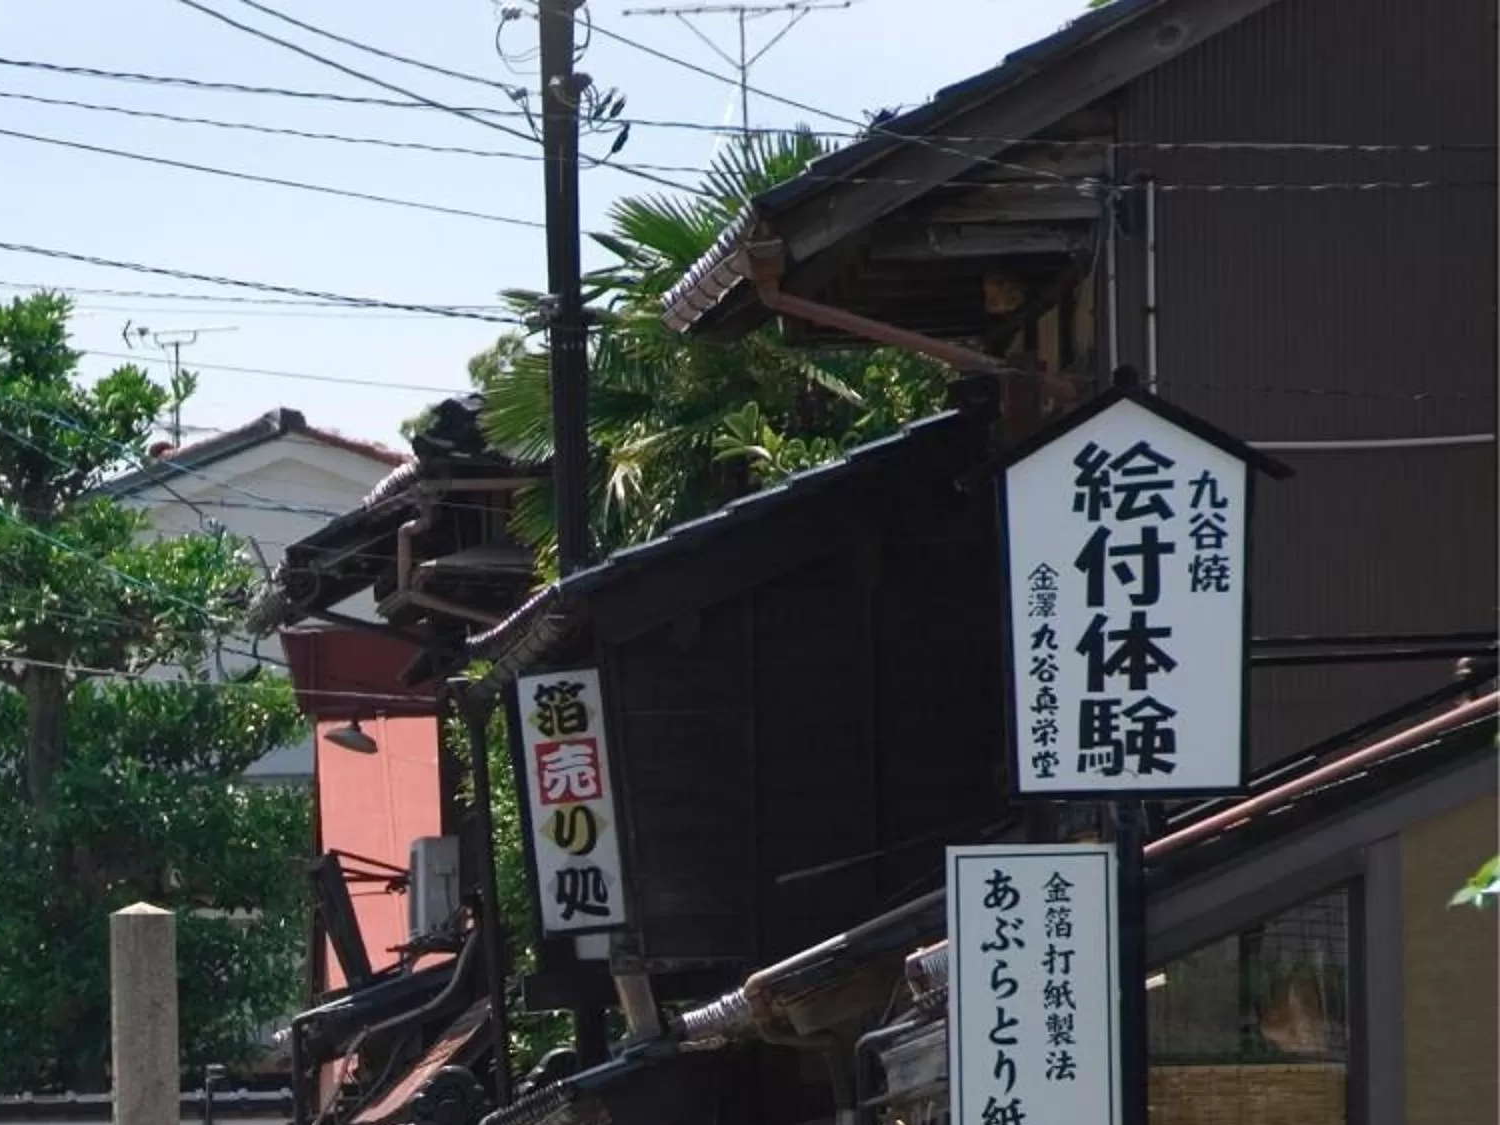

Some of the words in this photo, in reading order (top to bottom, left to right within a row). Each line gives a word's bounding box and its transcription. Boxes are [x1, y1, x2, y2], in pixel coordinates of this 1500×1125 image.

[1072, 440, 1178, 776] 絵付体験
[1188, 470, 1230, 593] 九谷焼
[534, 680, 610, 920] 箔売り処
[1041, 871, 1077, 1082] 金箔打紙製法
